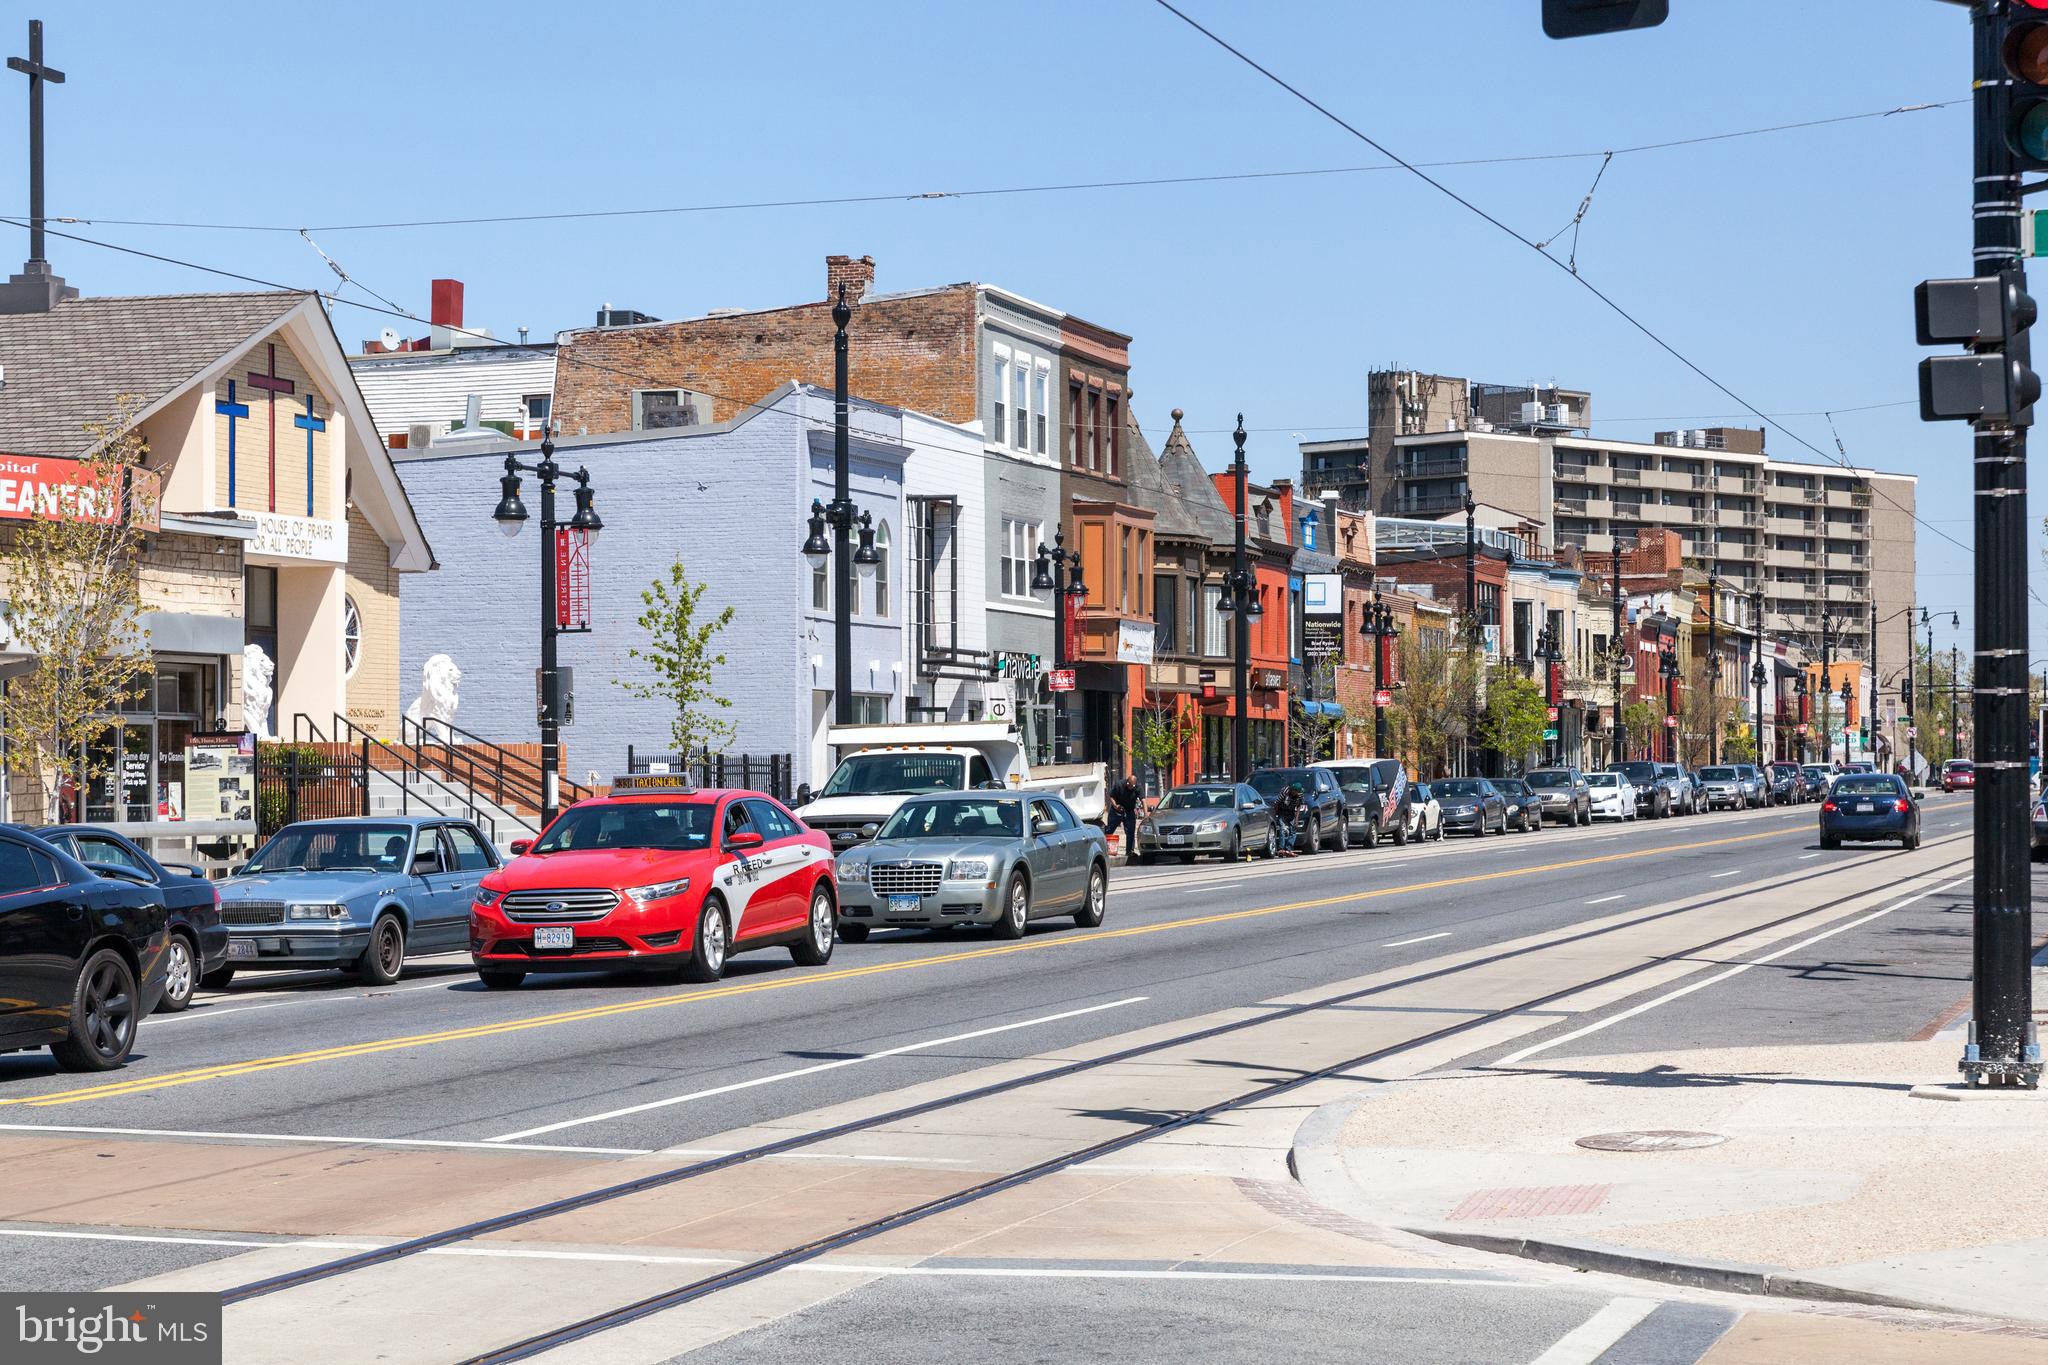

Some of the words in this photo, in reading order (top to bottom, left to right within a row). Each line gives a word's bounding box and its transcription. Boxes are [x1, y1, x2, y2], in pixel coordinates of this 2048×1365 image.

[260, 518, 288, 535] HOUSE
[292, 521, 303, 537] OF
[307, 523, 333, 540] PRAYER
[269, 537, 282, 552] ALL
[286, 538, 313, 555] PEOPLE
[123, 753, 138, 761] Same
[140, 752, 150, 762] day
[159, 752, 167, 763] Dry
[126, 762, 145, 770] Service
[636, 777, 651, 787] TAXI
[652, 776, 663, 787] ON
[664, 776, 682, 787] CALL
